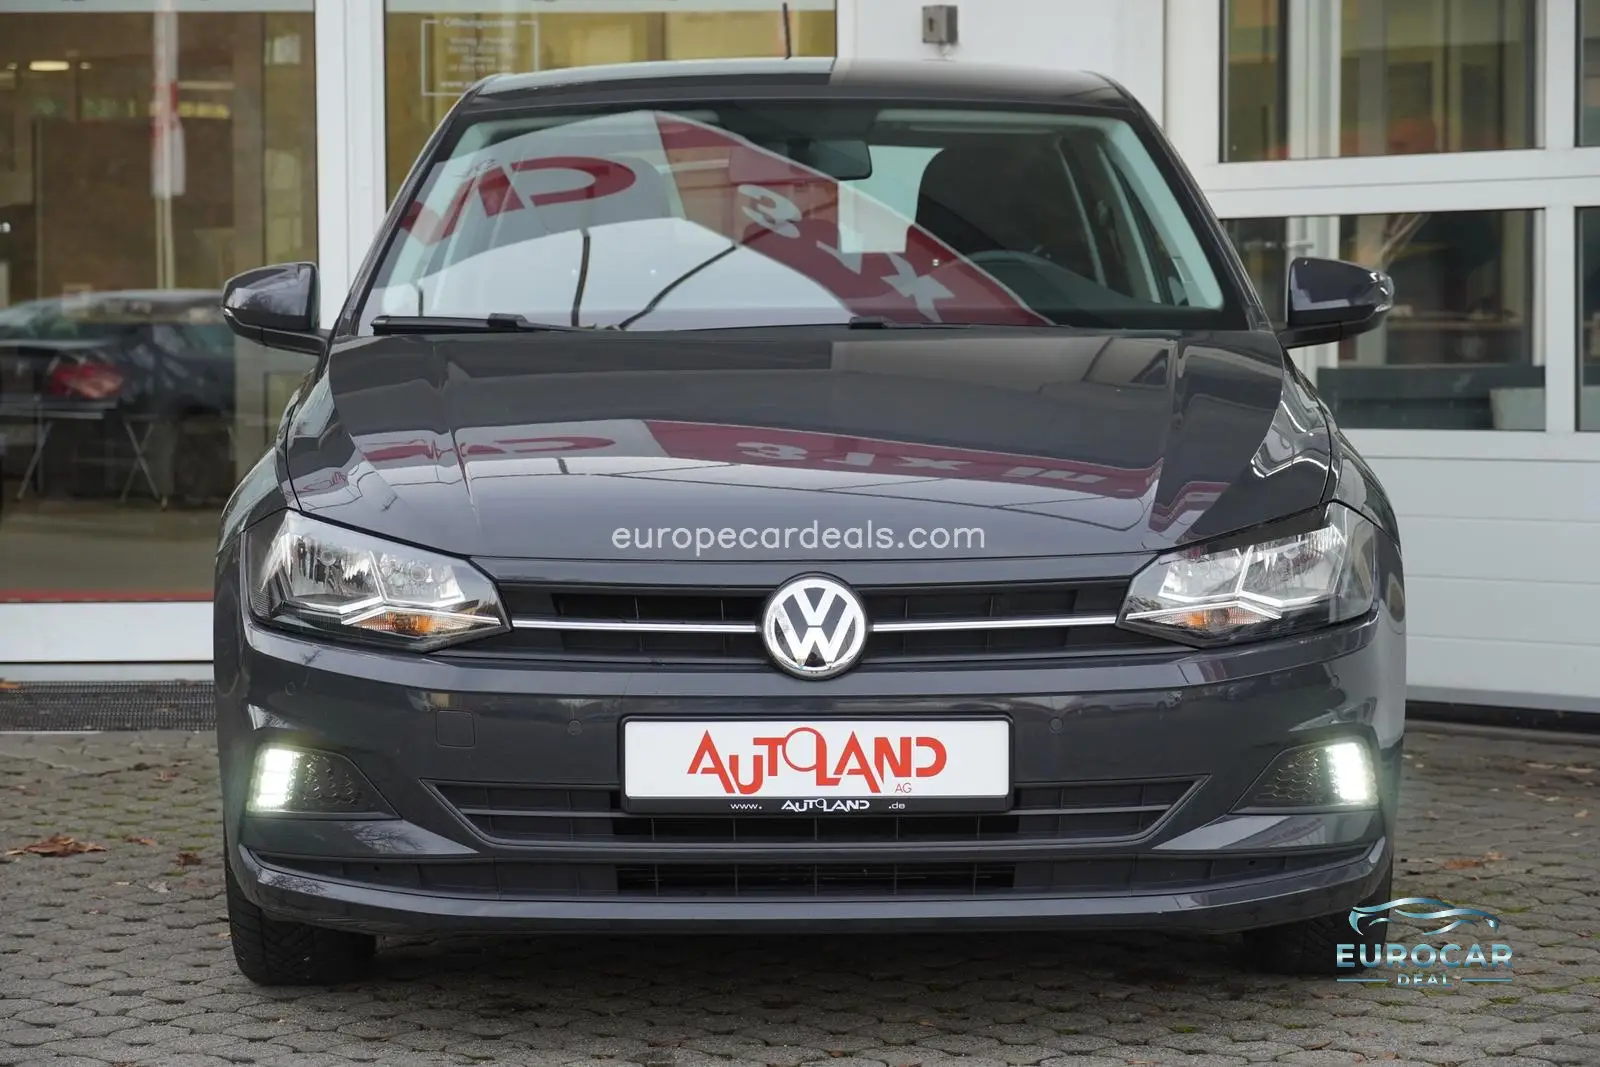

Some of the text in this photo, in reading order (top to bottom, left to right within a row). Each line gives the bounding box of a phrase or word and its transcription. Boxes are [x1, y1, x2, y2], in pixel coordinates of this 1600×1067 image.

[894, 783, 912, 794] AG
[781, 798, 870, 813] AUTOLAND
[888, 802, 905, 810] .de
